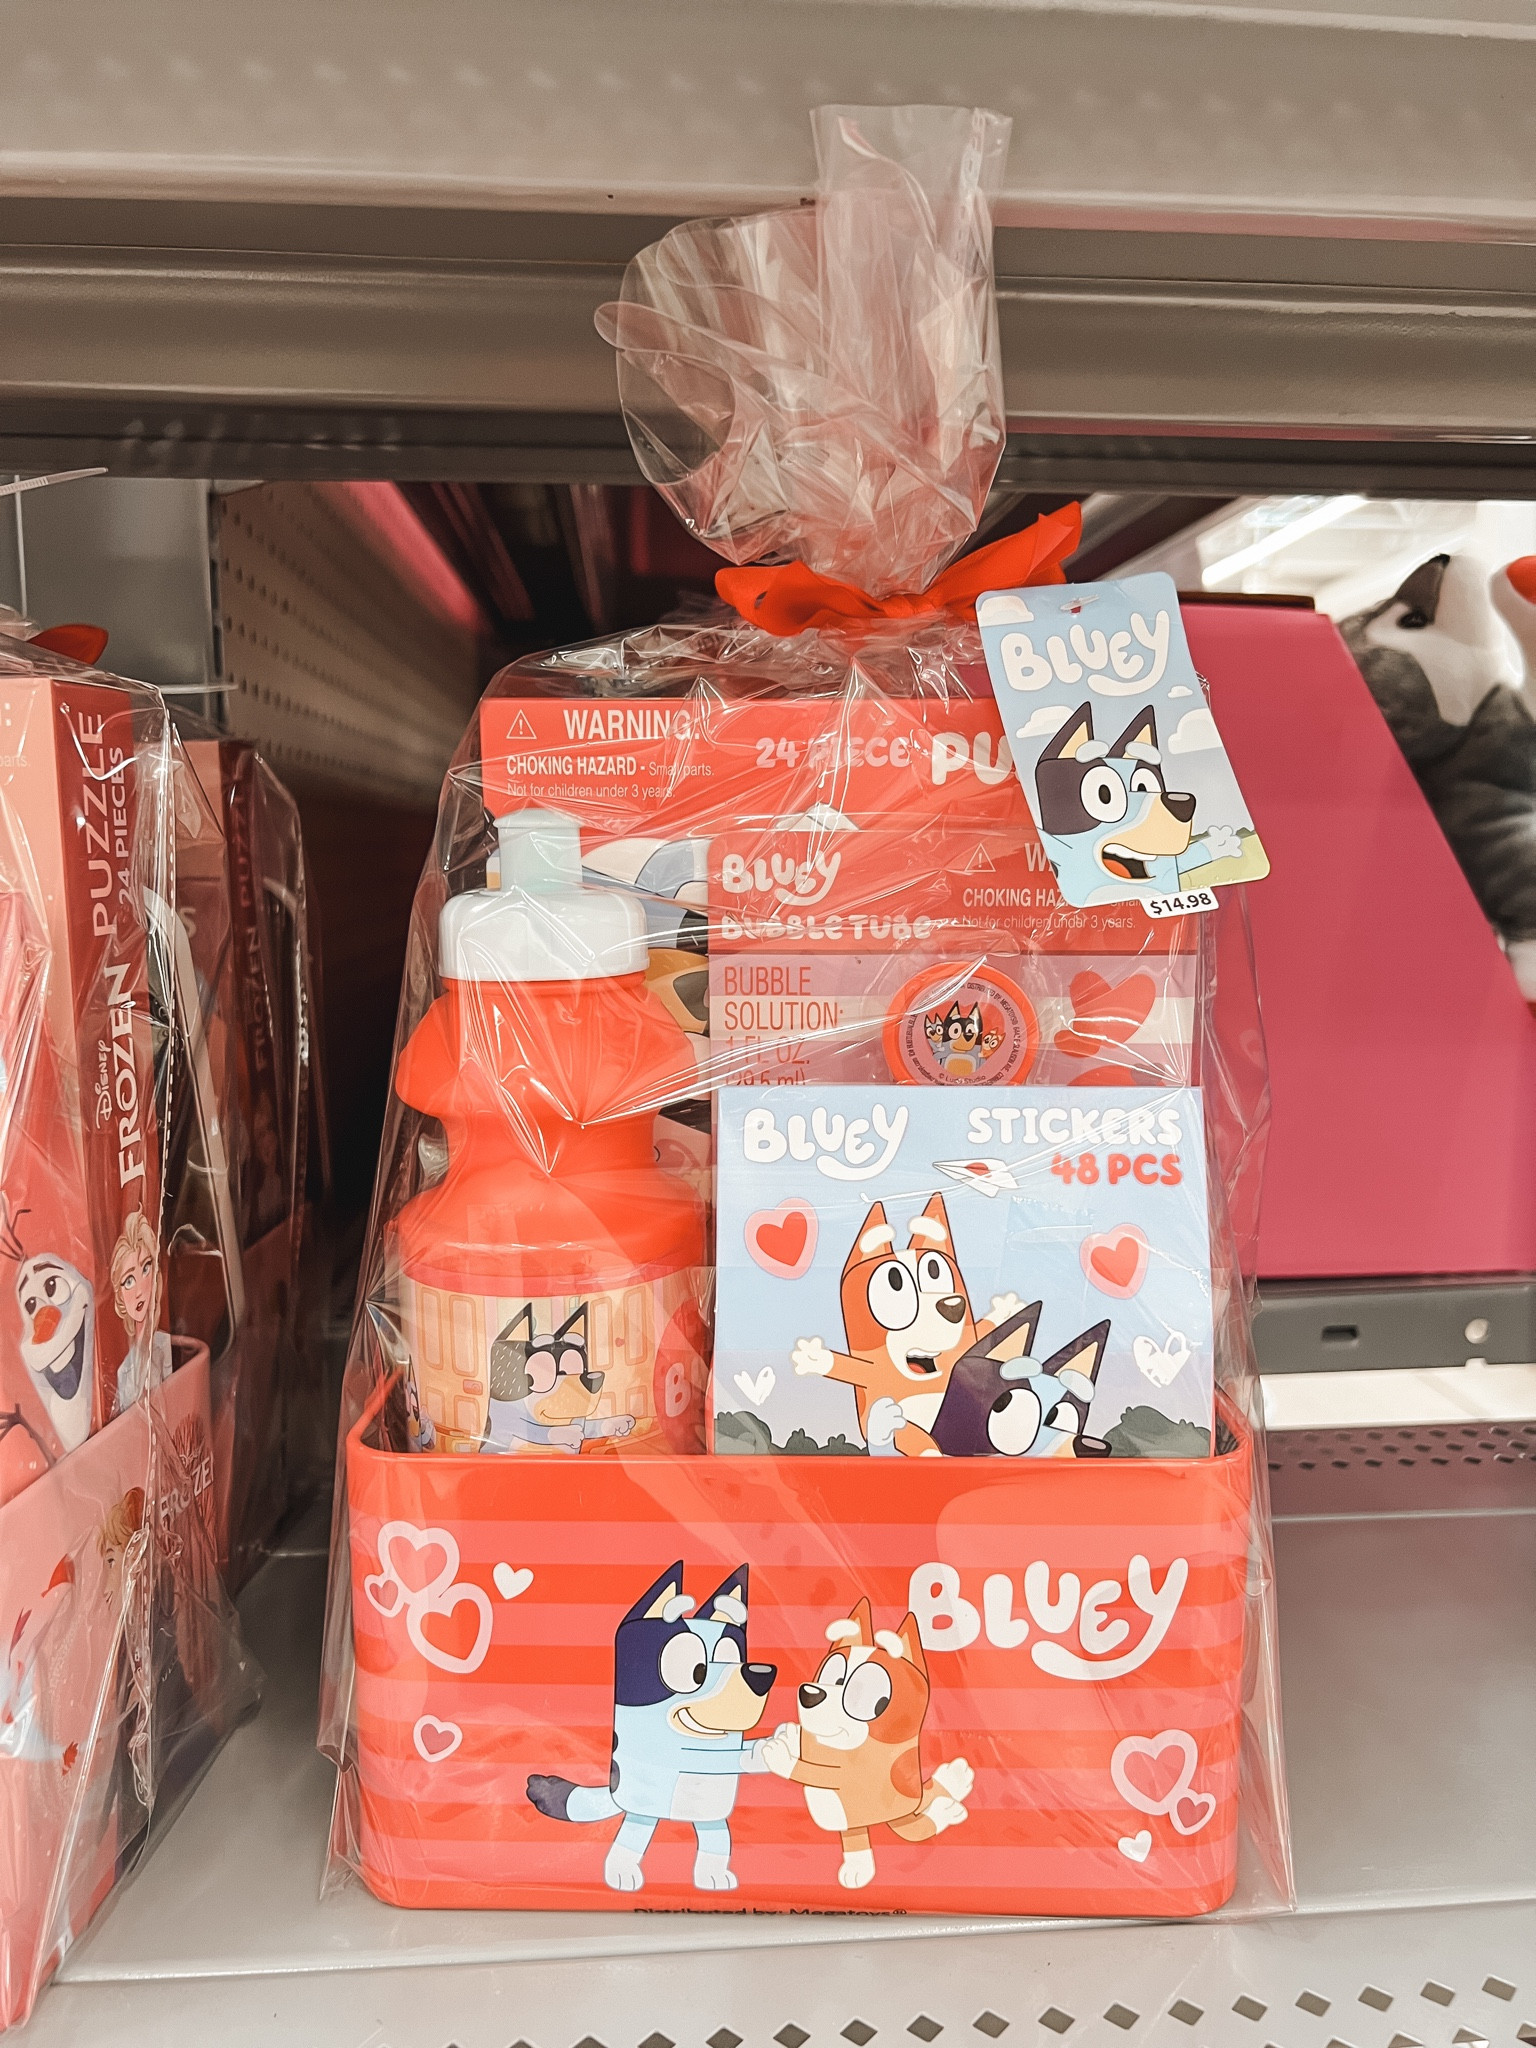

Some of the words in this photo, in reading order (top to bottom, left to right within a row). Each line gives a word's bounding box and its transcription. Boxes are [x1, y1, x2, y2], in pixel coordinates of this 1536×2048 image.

[563, 708, 701, 740] WARNING:
[506, 756, 573, 776] CHOKING
[577, 756, 637, 776] HAZARD
[683, 763, 714, 780] parts.
[755, 737, 800, 768] 24
[807, 736, 910, 768] PIECE
[110, 747, 129, 858] PIECES
[507, 784, 527, 798] Not
[530, 784, 545, 798] for
[548, 784, 593, 798] children
[596, 784, 628, 798] under
[631, 784, 639, 798] 3
[642, 785, 675, 800] years.
[78, 712, 118, 937] PUZZLE
[963, 888, 1031, 907] CHOKING
[1149, 892, 1212, 915] $14.98
[963, 915, 985, 928] Not
[987, 915, 1000, 928] for
[1004, 915, 1050, 928] children
[1054, 915, 1086, 928] under
[1091, 916, 1098, 928] 3
[1103, 917, 1136, 931] years.
[724, 966, 811, 996] BUBBLE
[104, 962, 146, 1189] FROZEN
[968, 1106, 1182, 1146] STICKERS
[1051, 1153, 1099, 1185] 48
[1110, 1153, 1182, 1185] PCS
